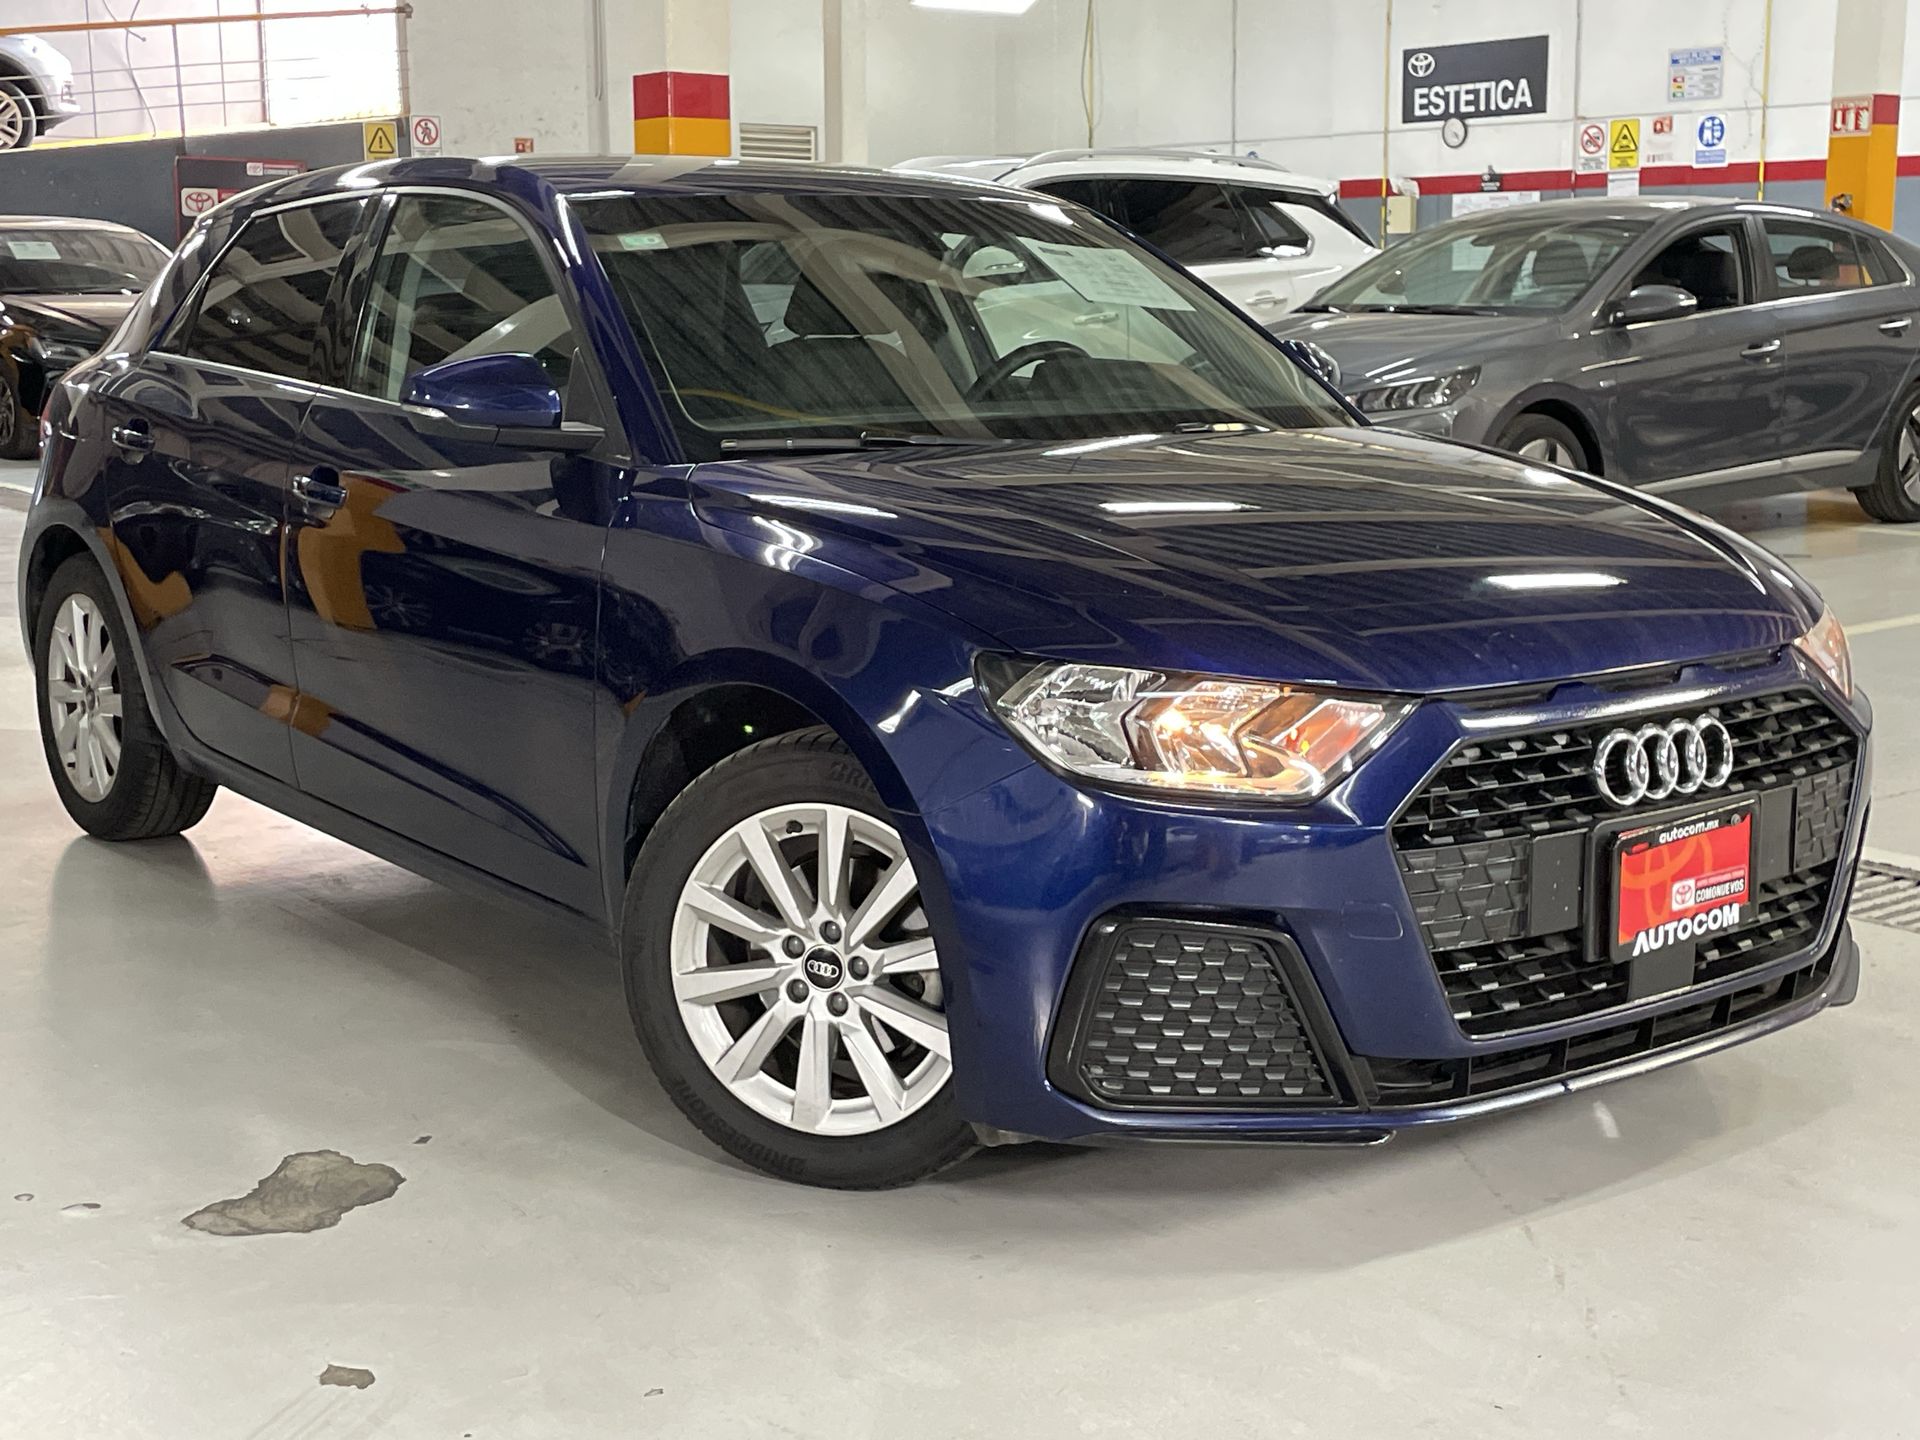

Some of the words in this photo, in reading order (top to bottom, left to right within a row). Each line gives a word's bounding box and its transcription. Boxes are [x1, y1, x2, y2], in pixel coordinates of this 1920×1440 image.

[1413, 78, 1533, 117] ESTETICA
[1658, 819, 1720, 844] autocom.mx
[1632, 902, 1741, 957] AUTOCOM
